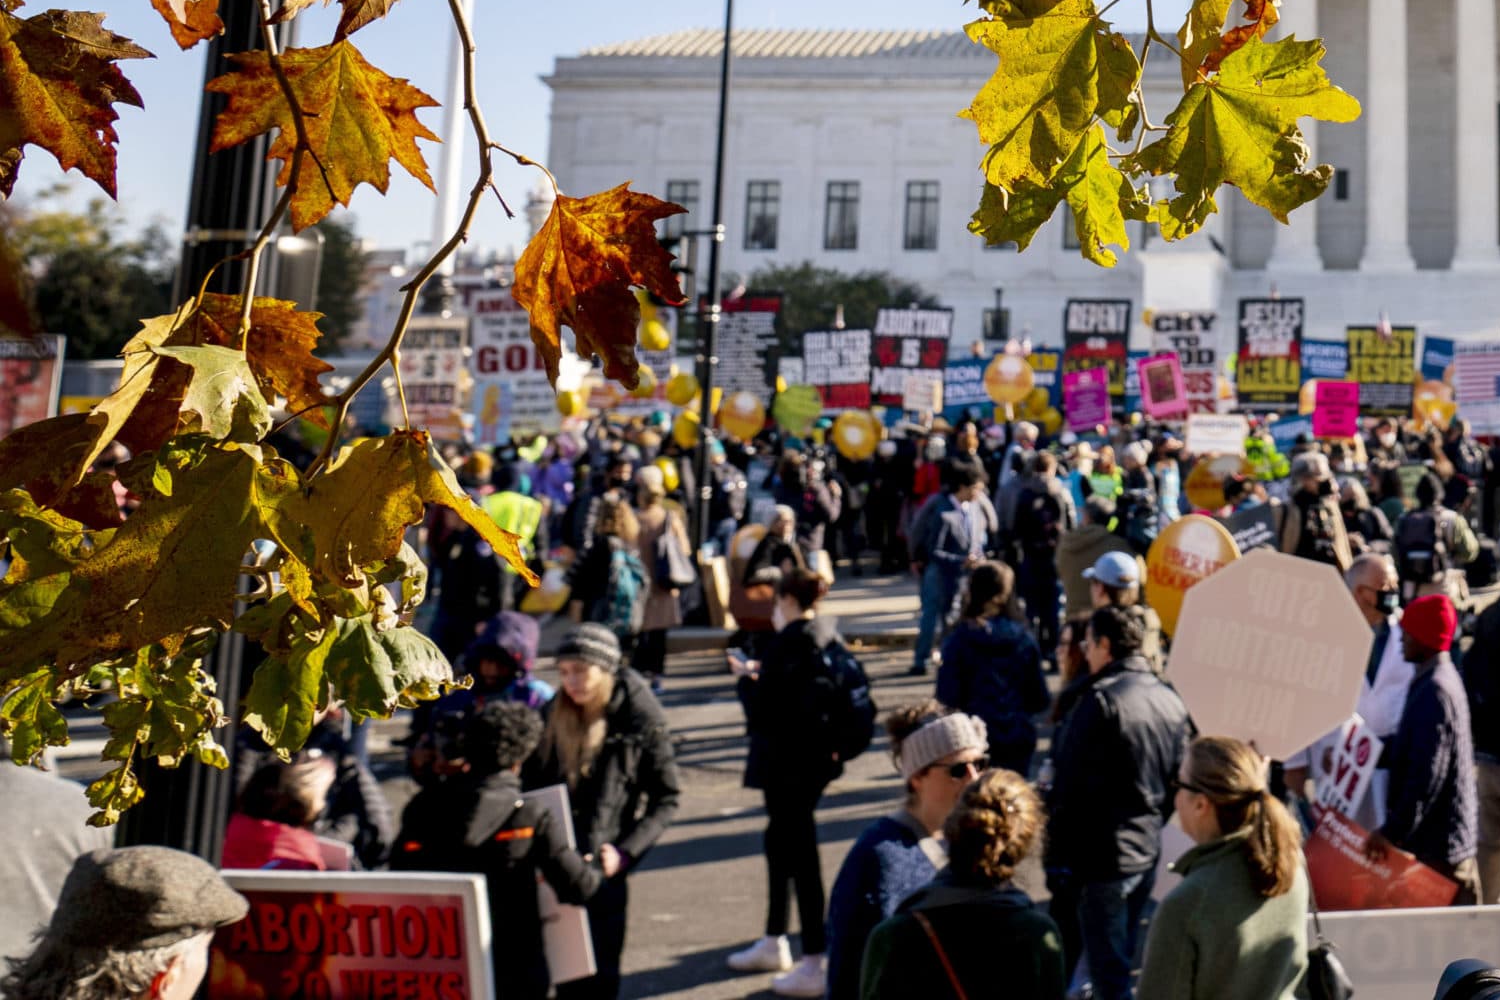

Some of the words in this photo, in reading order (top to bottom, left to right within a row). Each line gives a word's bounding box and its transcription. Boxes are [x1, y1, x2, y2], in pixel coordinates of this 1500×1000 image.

[1154, 313, 1216, 332] CRY
[1243, 303, 1302, 323] JESUS
[1348, 329, 1415, 355] TRUST
[1239, 357, 1298, 387] HELL
[1348, 356, 1415, 383] JESUS
[231, 903, 462, 959] ABORTION
[339, 968, 463, 1000] WEEKS
